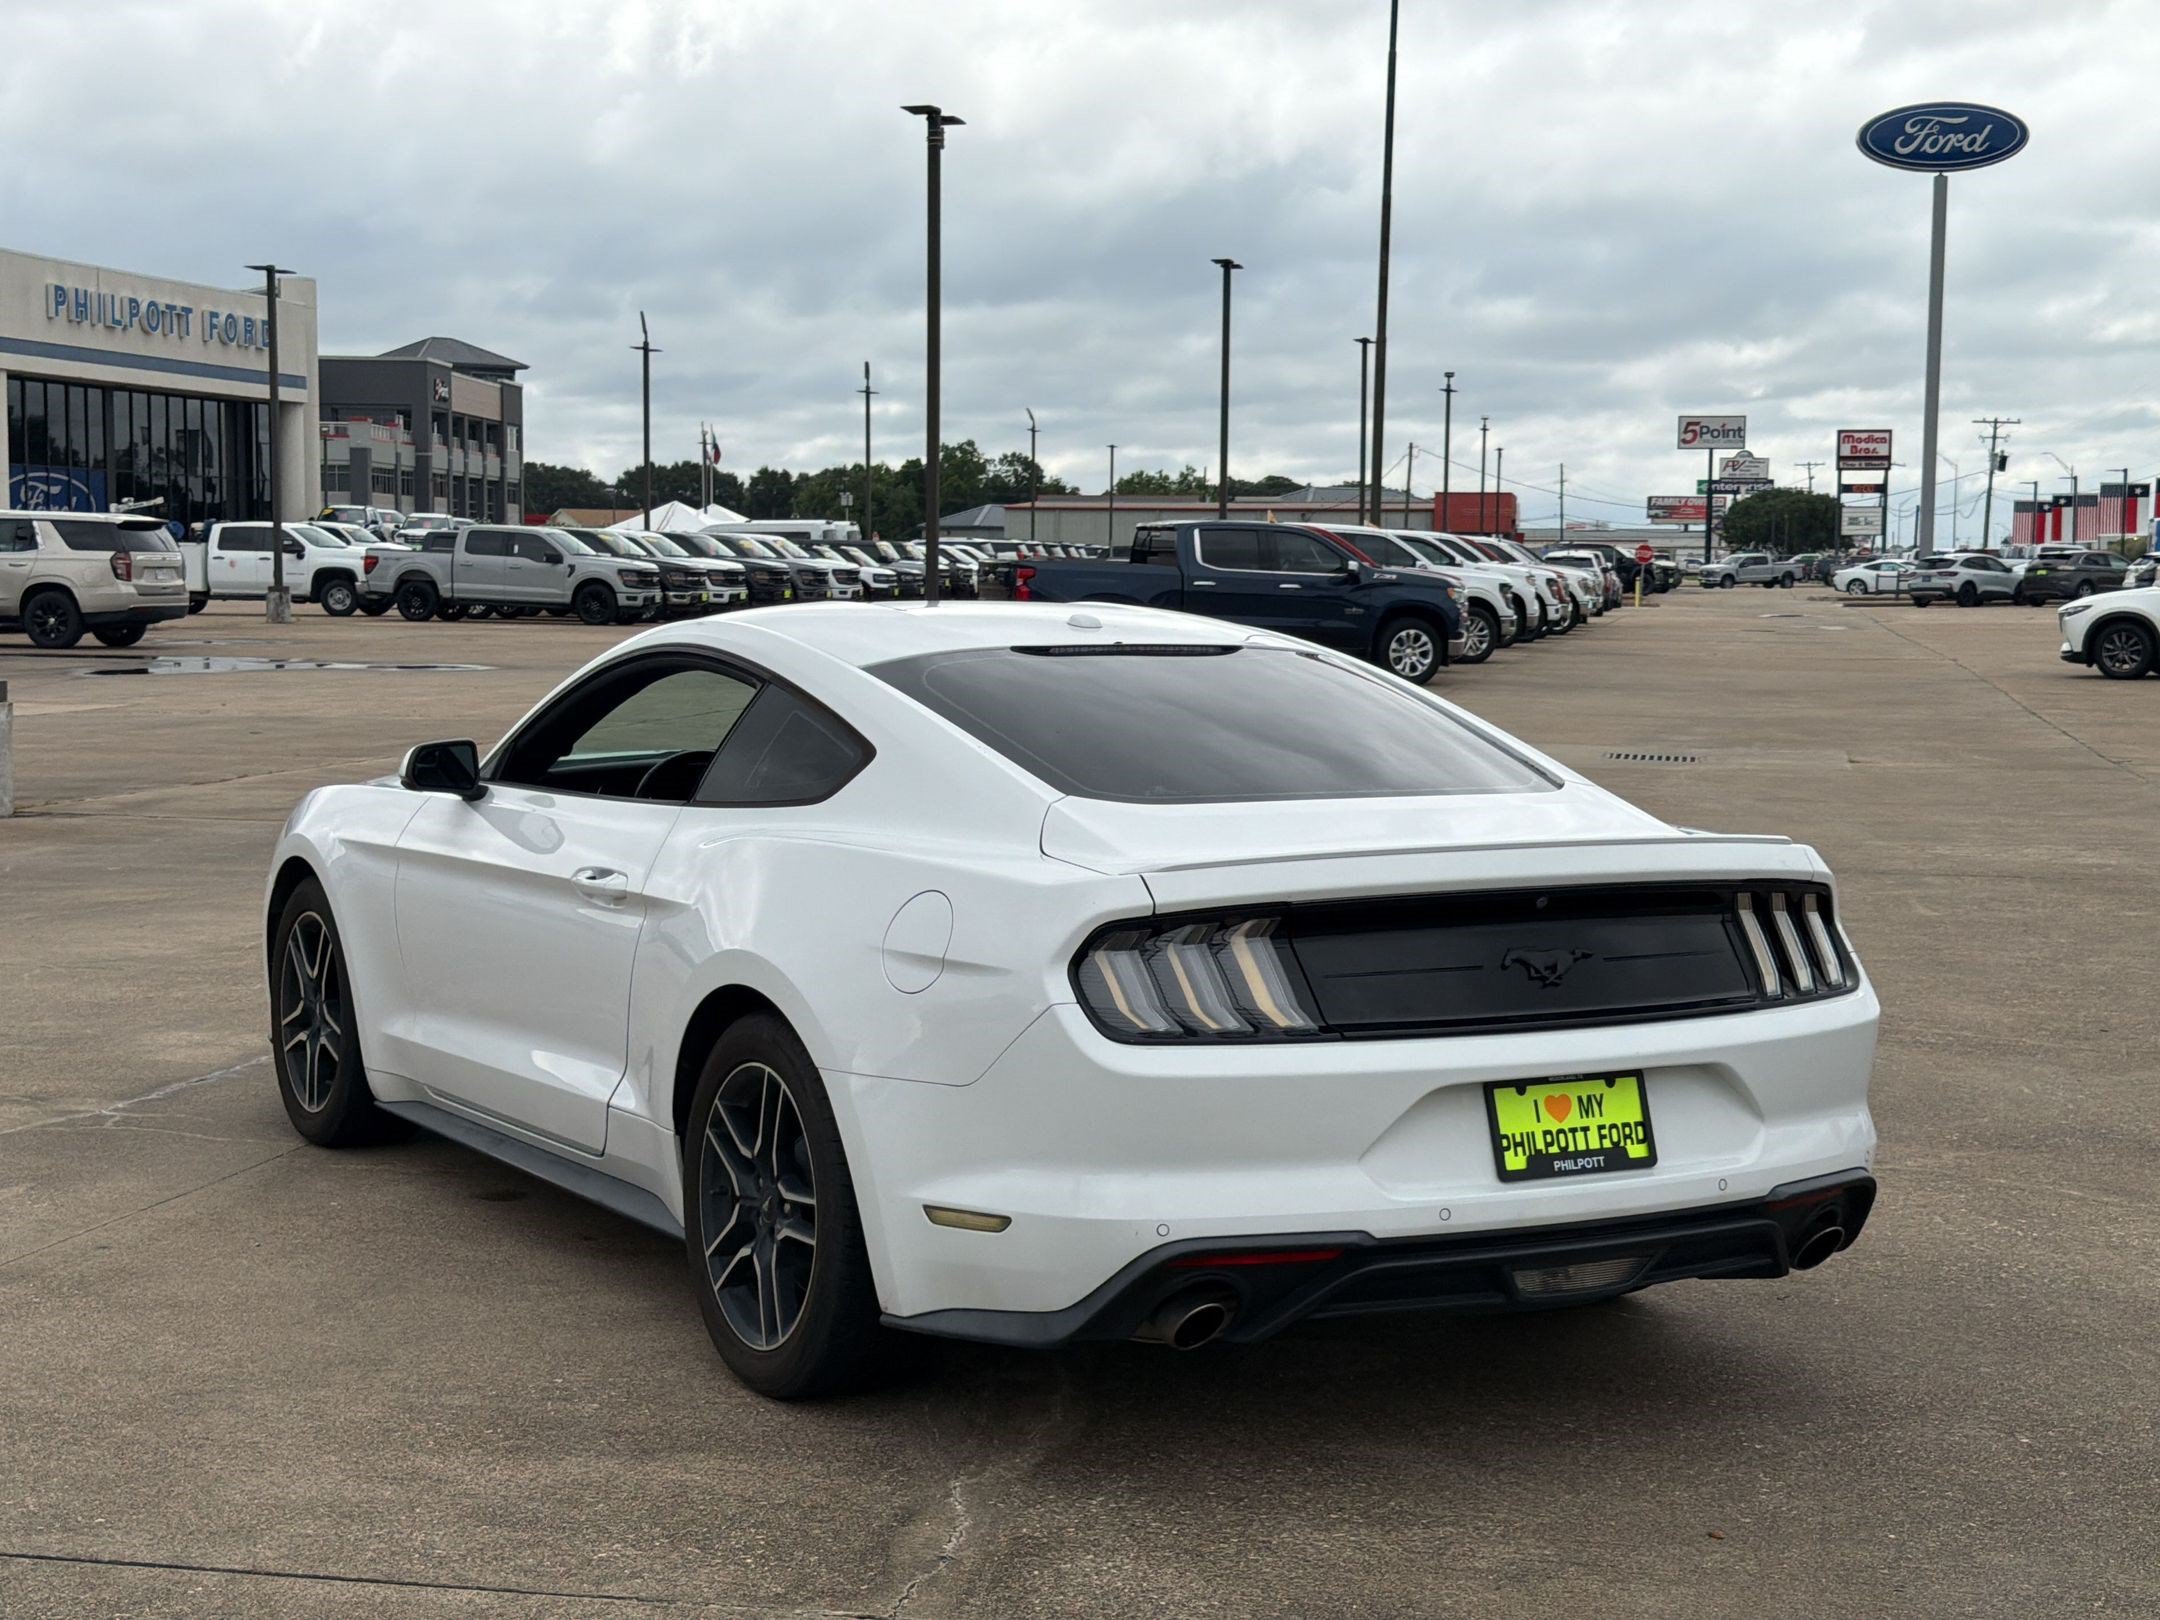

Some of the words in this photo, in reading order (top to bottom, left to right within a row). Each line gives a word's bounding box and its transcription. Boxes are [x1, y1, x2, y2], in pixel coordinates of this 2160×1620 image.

[1894, 115, 1993, 155] Ford
[49, 284, 194, 335] PHILPOTT
[1842, 434, 1888, 444] Modica
[1650, 497, 1687, 506] FAMILY
[1533, 1098, 1541, 1123] I
[1576, 1093, 1604, 1119] MY
[1500, 1125, 1591, 1157] PHILPOTT
[1597, 1120, 1648, 1148] FORD
[1553, 1155, 1605, 1172] PHILPOTT
